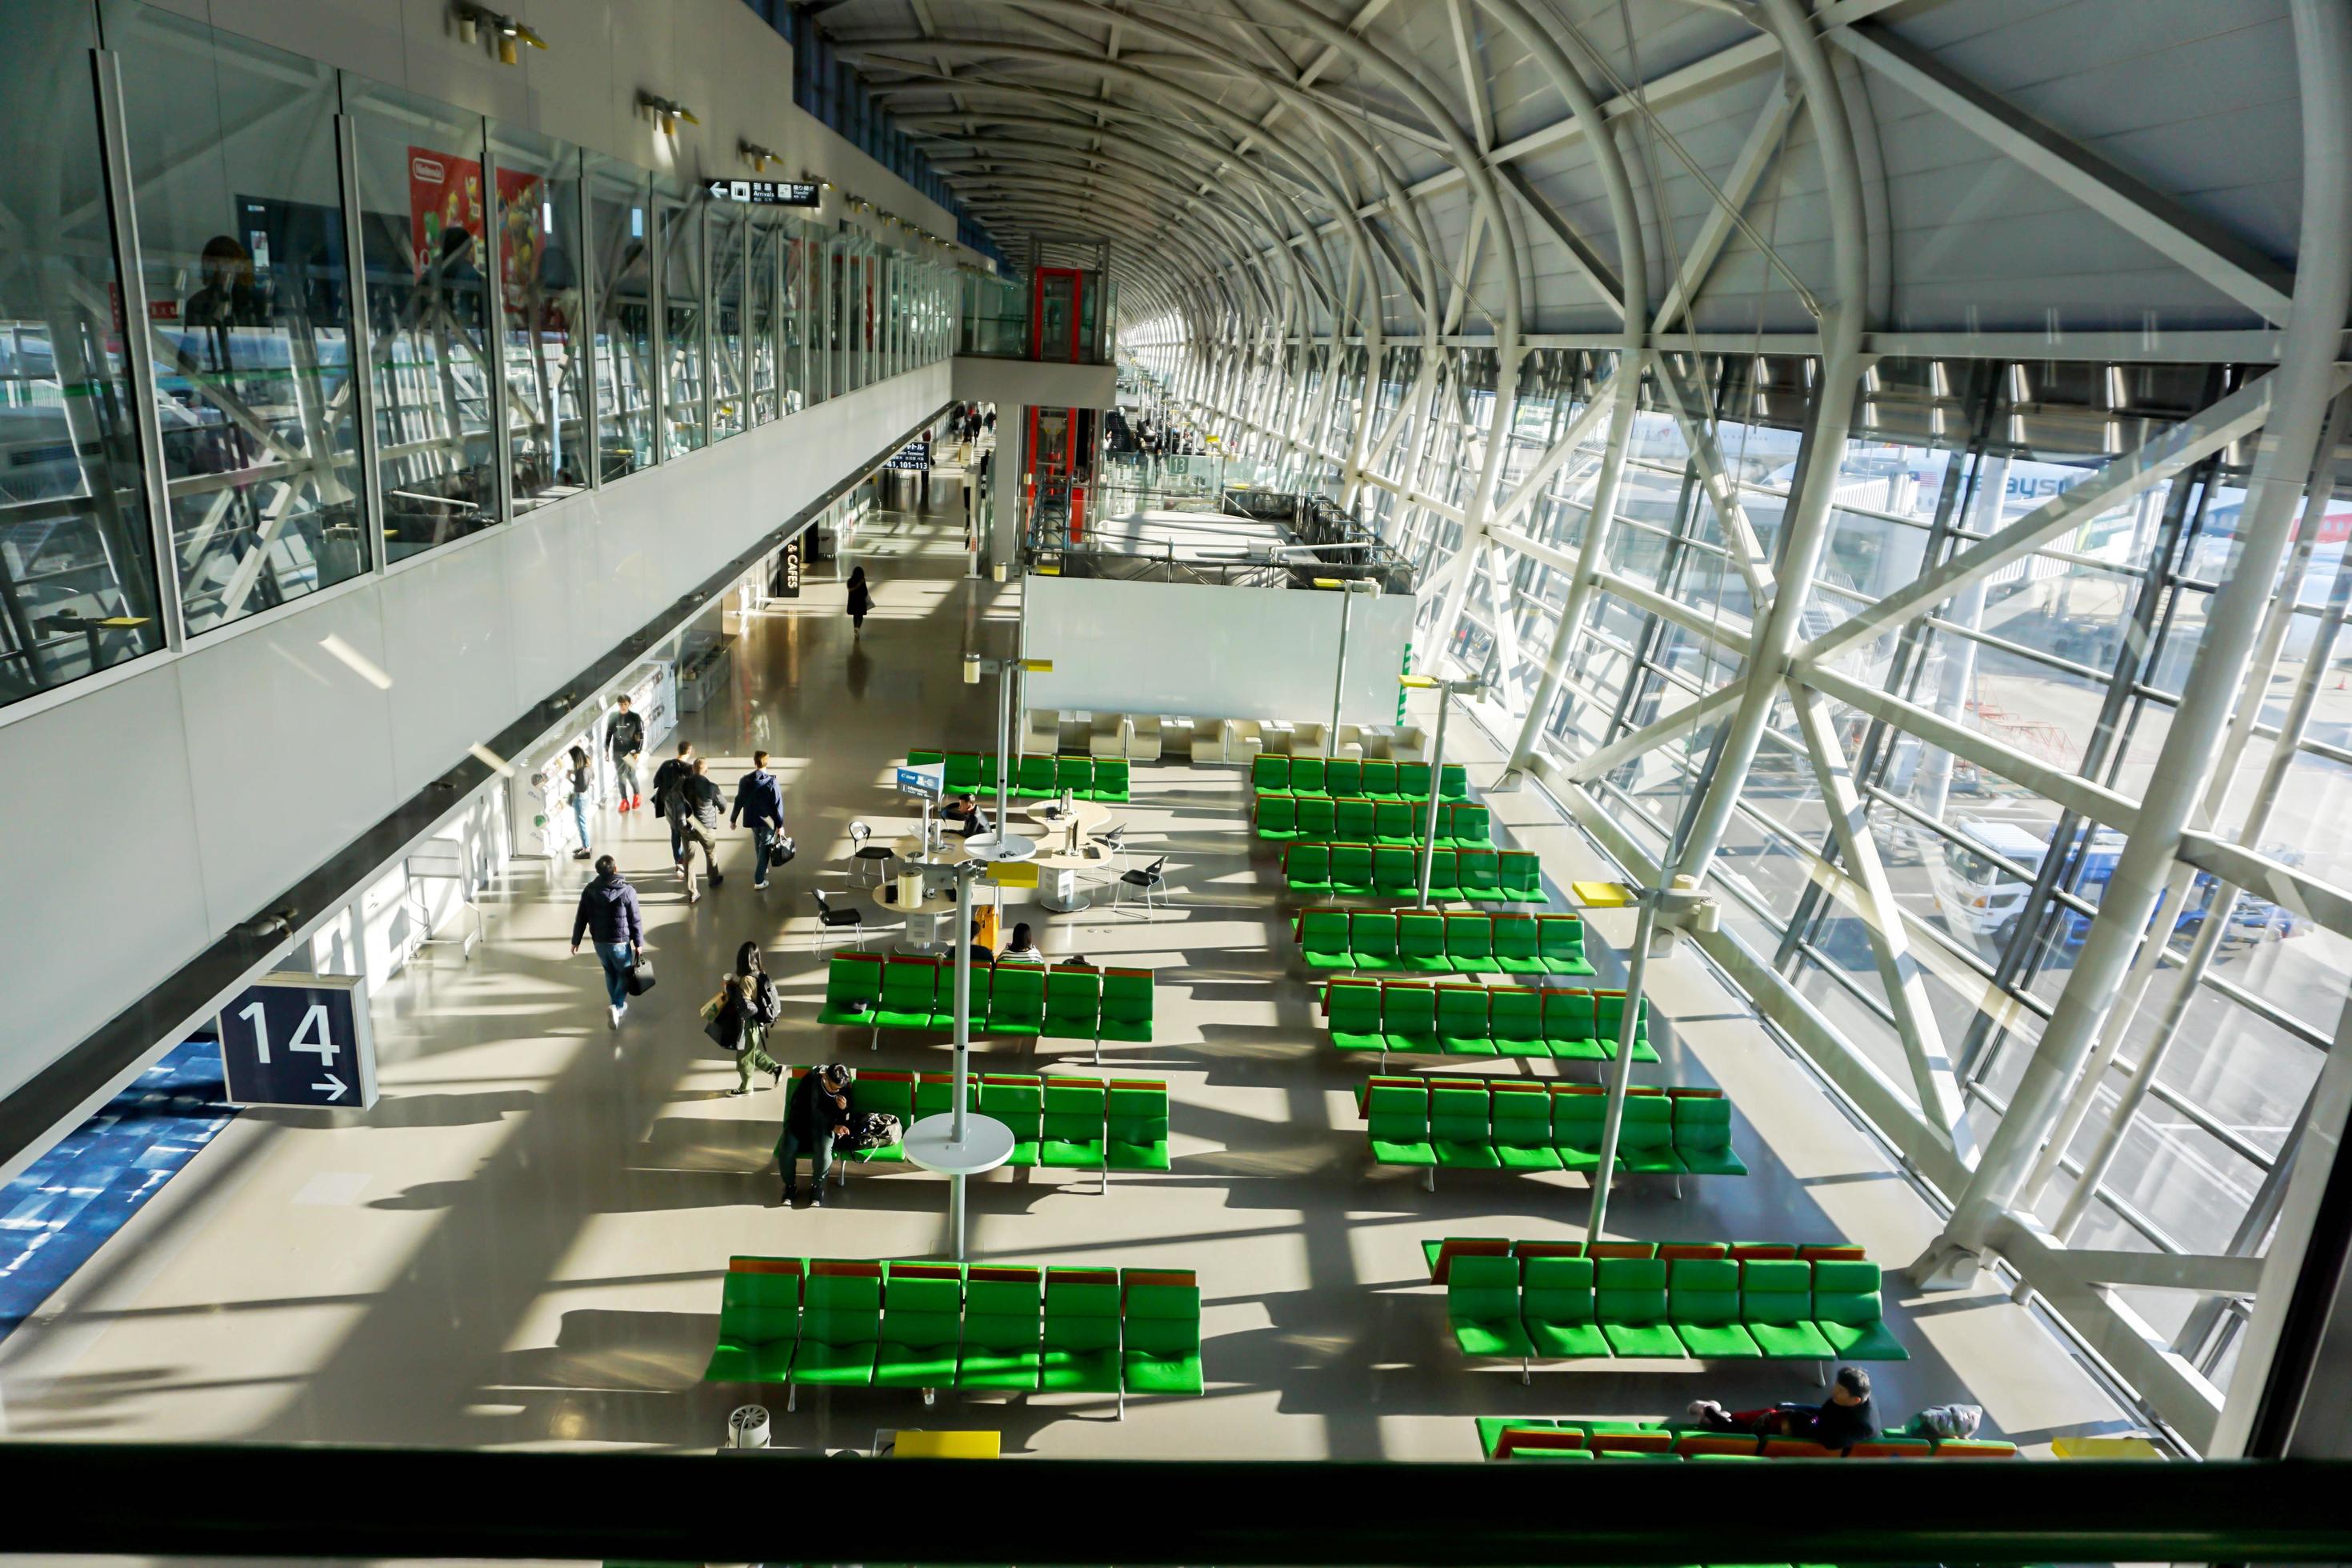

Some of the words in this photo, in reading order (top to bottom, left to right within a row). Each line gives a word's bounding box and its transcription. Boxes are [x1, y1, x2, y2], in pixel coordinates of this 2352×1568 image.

[1174, 458, 1186, 473] 13
[787, 554, 798, 589] CAFES
[238, 1002, 341, 1066] 14
